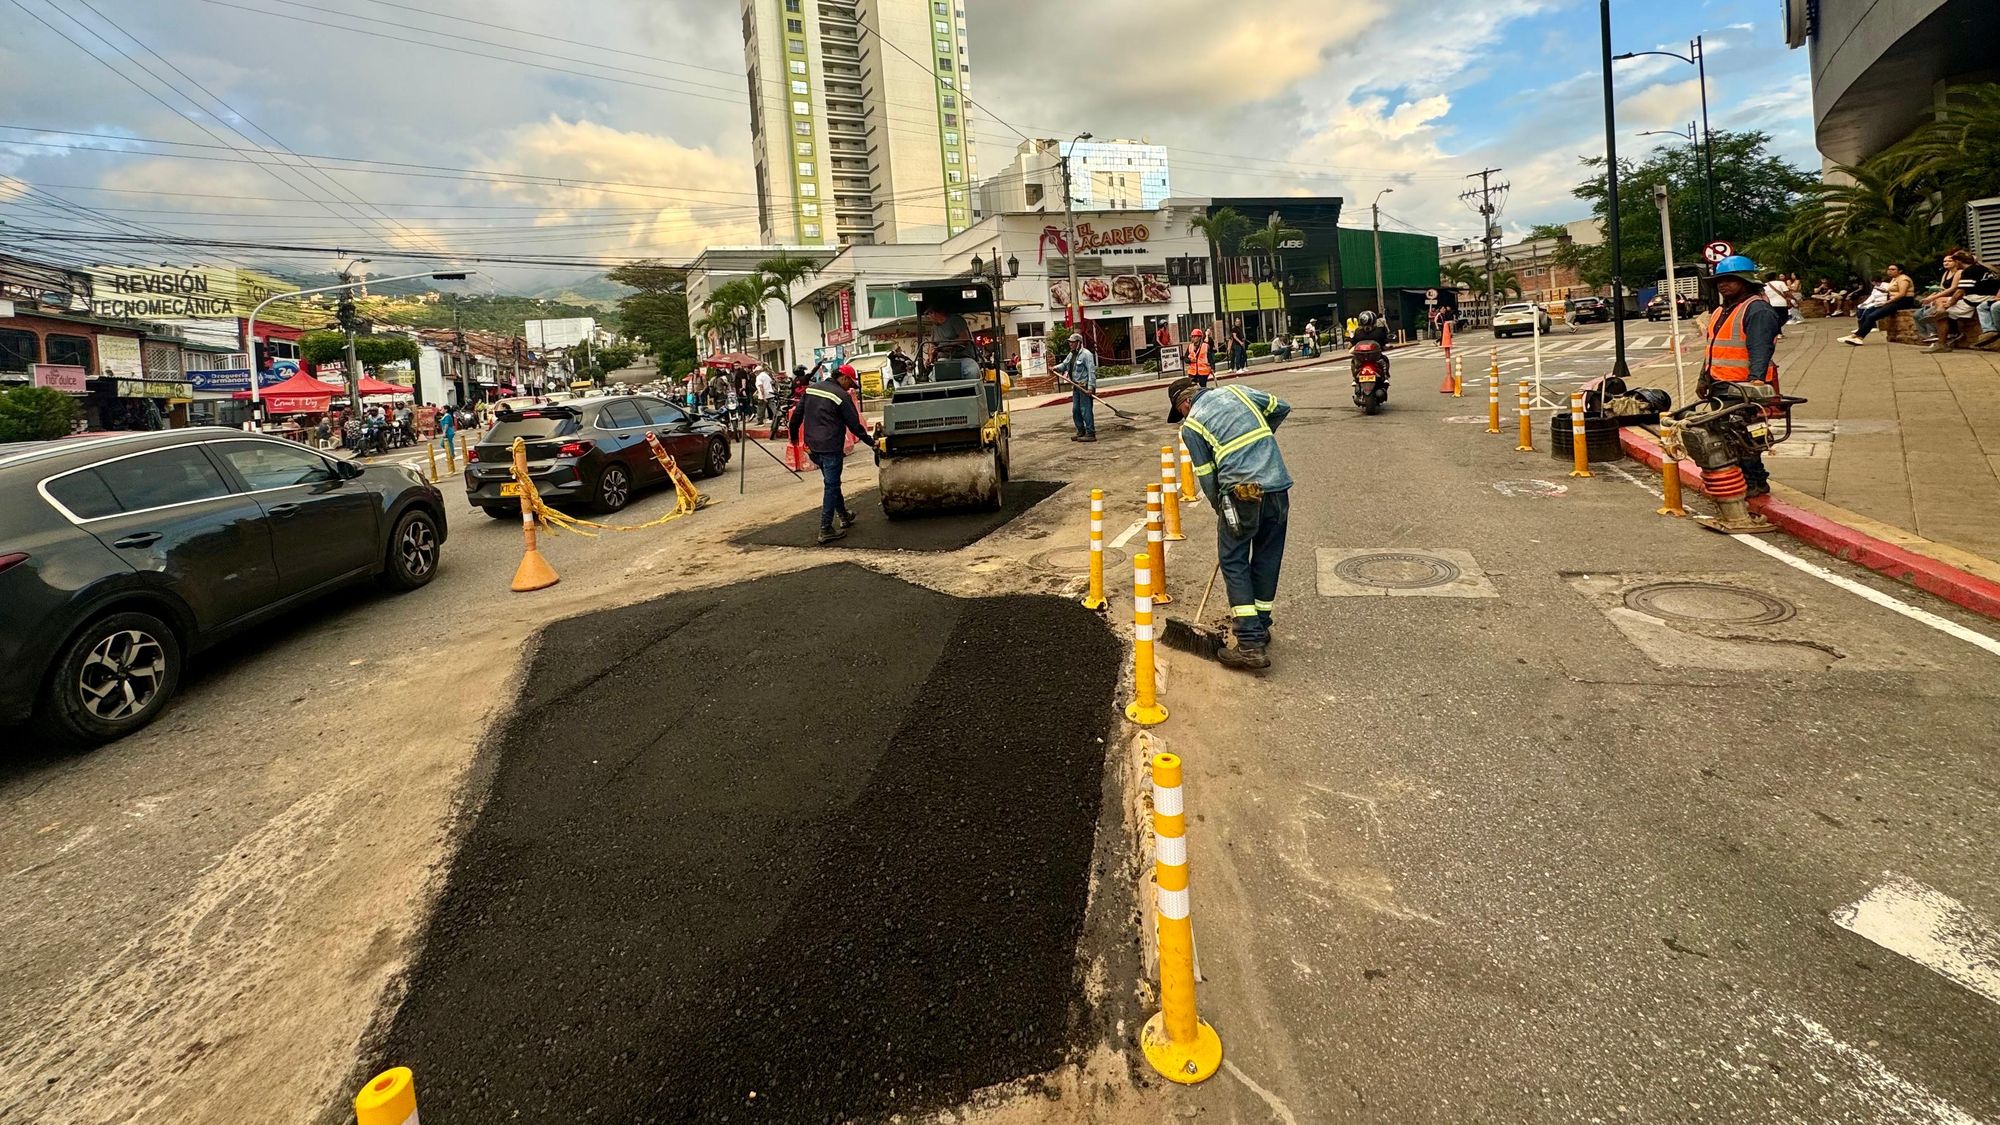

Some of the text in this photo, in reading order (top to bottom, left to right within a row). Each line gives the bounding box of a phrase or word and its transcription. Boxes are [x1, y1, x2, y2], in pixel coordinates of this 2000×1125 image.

[1077, 223, 1095, 237] EL
[1073, 224, 1149, 254] CACAREO
[1113, 248, 1122, 256] que
[115, 270, 208, 294] REVISIÓN
[92, 296, 234, 316] TECNOMECÁNICA
[278, 367, 295, 377] 24
